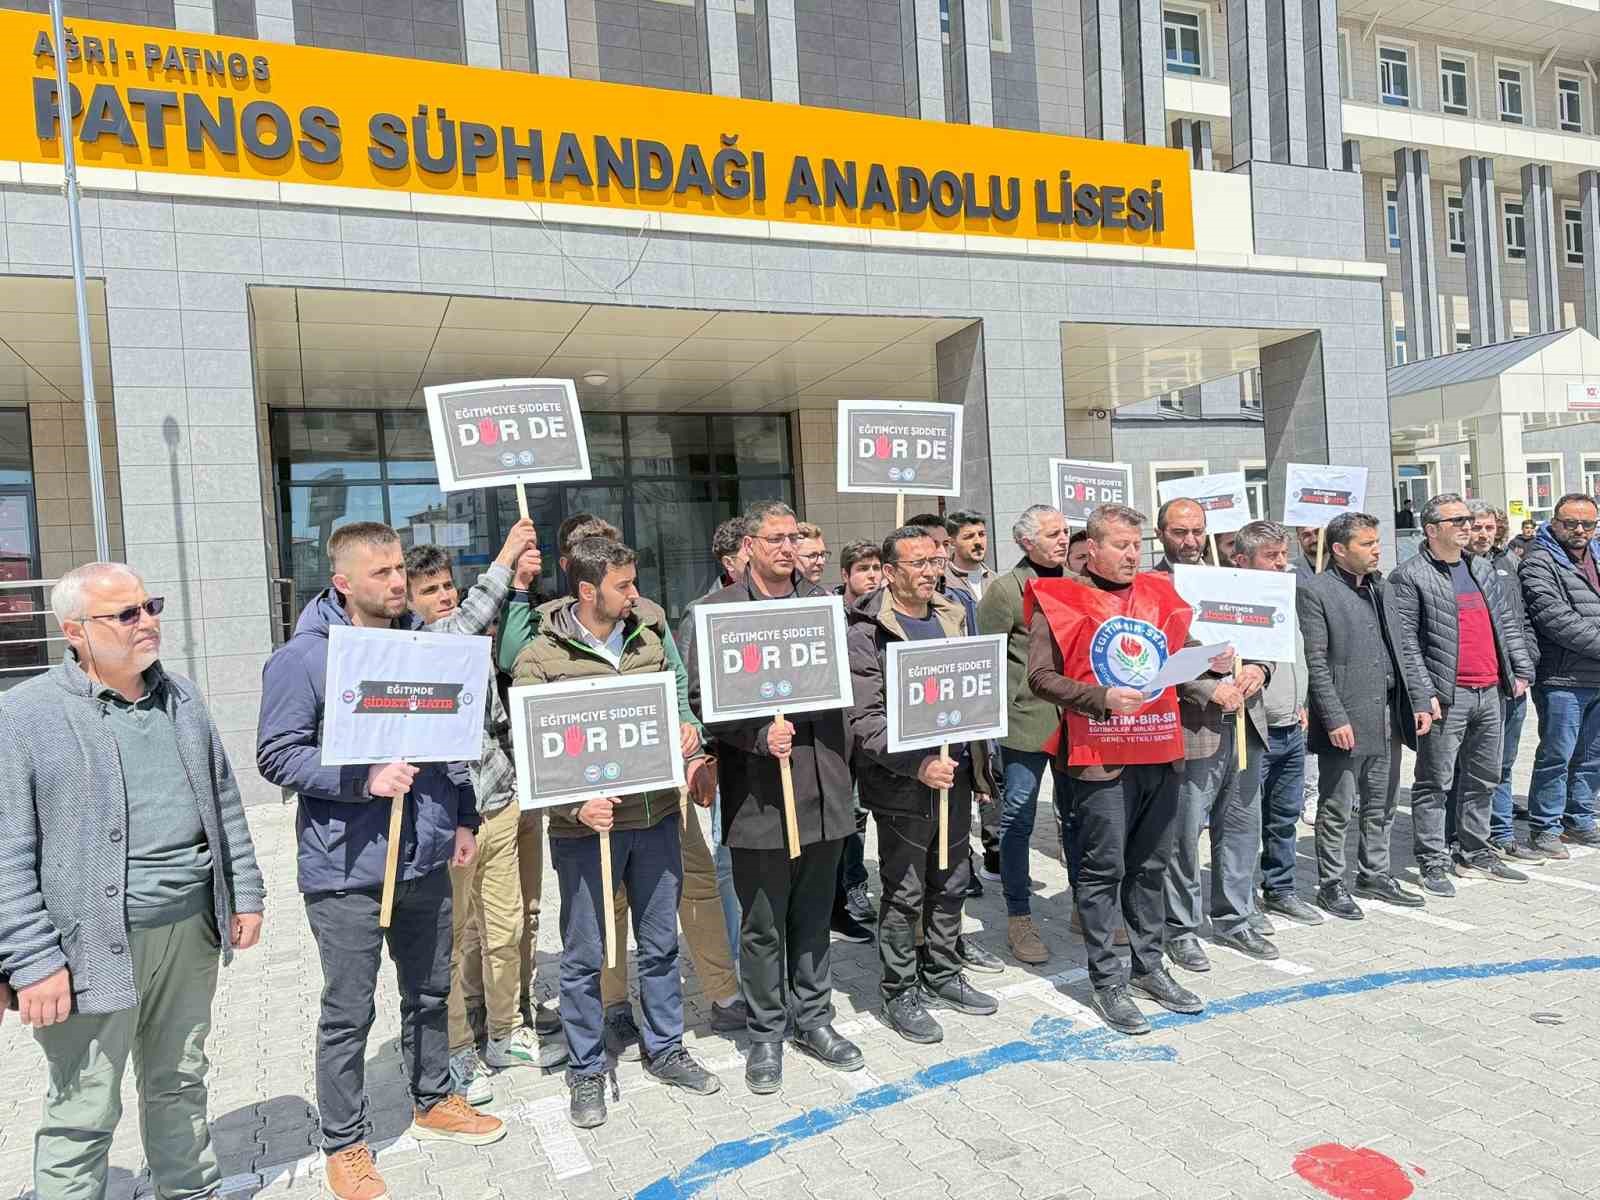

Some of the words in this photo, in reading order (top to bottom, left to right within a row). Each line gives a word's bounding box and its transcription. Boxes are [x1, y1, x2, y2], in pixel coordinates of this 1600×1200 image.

[33, 27, 118, 65] AĞRI
[143, 43, 270, 81] PATNOS
[32, 76, 341, 165] PATNOS
[367, 104, 766, 202] SÜPHANDAĞI
[785, 155, 1021, 222] ANADOLU
[1034, 169, 1165, 233] LİSESİ
[528, 416, 567, 439] DE
[916, 439, 947, 460] DE
[1101, 488, 1123, 503] DE
[790, 641, 828, 667] DE
[961, 673, 993, 698] DE
[618, 720, 660, 749] DE
